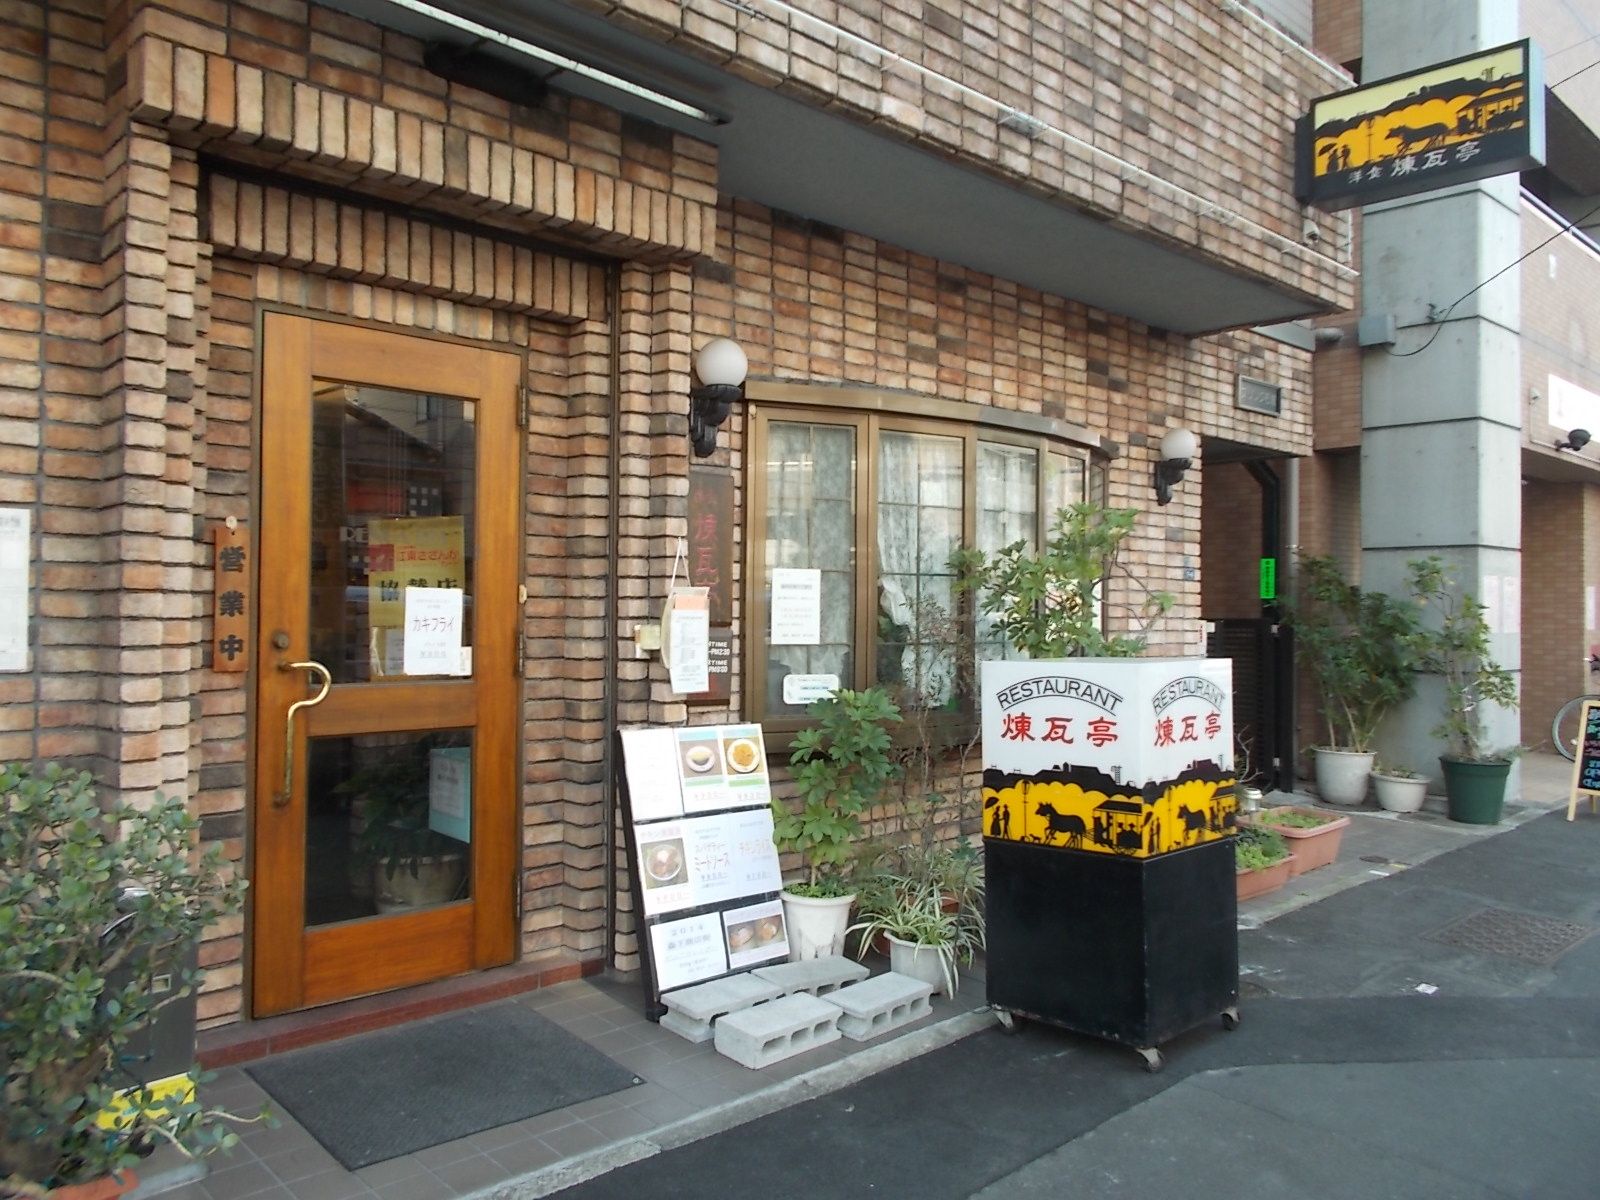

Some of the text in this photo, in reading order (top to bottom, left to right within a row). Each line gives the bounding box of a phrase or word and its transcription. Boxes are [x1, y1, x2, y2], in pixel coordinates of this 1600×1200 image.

[1390, 140, 1482, 177] 煉瓦亭
[219, 545, 246, 662] 営業中
[411, 615, 456, 633] カキフライ
[997, 678, 1123, 711] RESTAURANT
[1152, 678, 1226, 712] RESTAURANT
[1000, 711, 1119, 748] 煉瓦亭
[1153, 710, 1223, 748] 煉瓦亭
